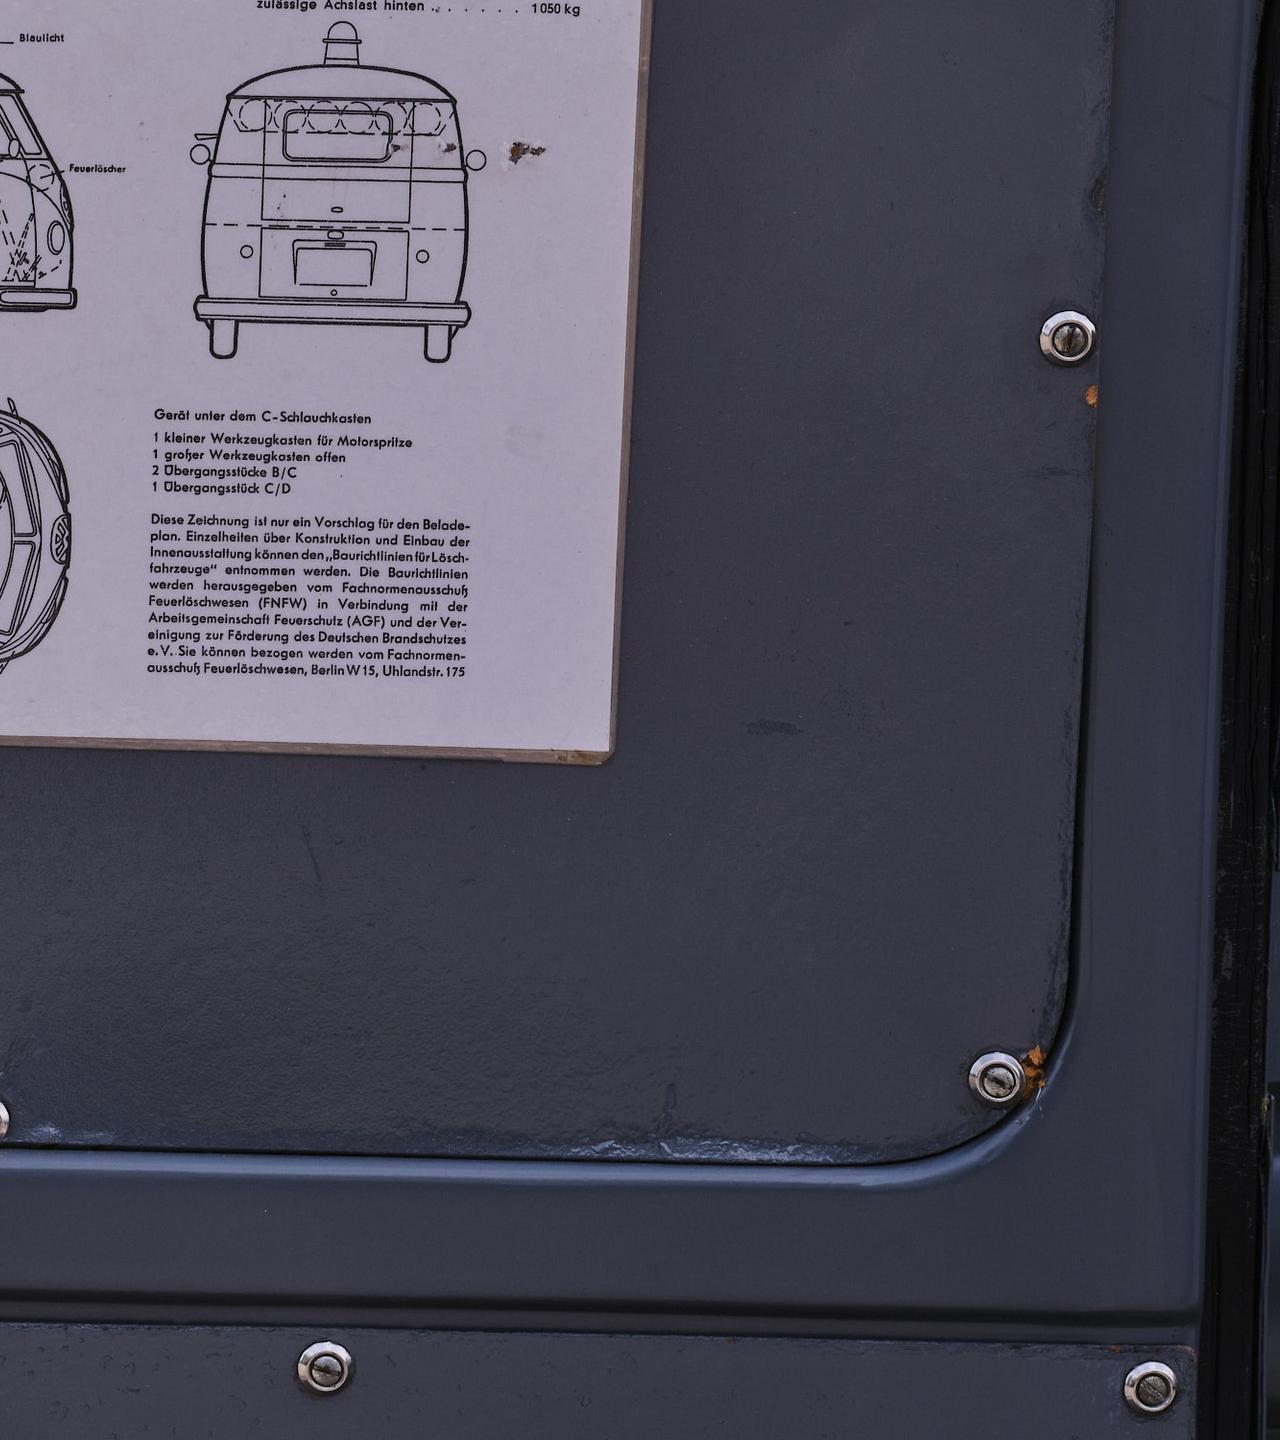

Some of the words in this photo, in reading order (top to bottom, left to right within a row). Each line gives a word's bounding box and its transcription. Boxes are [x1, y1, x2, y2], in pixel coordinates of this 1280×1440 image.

[383, 0, 425, 12] hinten
[564, 2, 581, 18] kg
[19, 32, 65, 43] Blaulicht
[68, 163, 127, 174] Feuerlöscher
[153, 407, 190, 421] Gerät
[194, 410, 226, 422] unter
[229, 409, 257, 422] dem
[261, 409, 372, 425] C-Schlauchkasten
[154, 431, 159, 443] 1
[164, 431, 206, 444] kleiner
[210, 432, 313, 448] Werkzeugkasten
[316, 434, 334, 447] für
[336, 434, 413, 451] Motorspritze
[152, 448, 158, 460] 1
[164, 448, 205, 463] großer
[208, 448, 311, 464] Werkzeugkasten
[314, 450, 346, 463] offen
[151, 464, 160, 476] 2
[164, 464, 267, 480] Übergangsstücke
[272, 466, 297, 480] B/C
[152, 480, 158, 493] 1
[163, 480, 260, 497] Übergangsstück
[264, 482, 292, 497] C/D
[150, 512, 185, 525] Diese
[186, 513, 250, 529] Zeichnung
[254, 515, 268, 527] ist
[270, 518, 290, 528] nur
[292, 516, 312, 528] ein
[314, 515, 375, 532] Vorschlag
[377, 517, 394, 530] für
[396, 517, 420, 530] den
[422, 518, 471, 531] Belade-
[150, 529, 181, 544] plan.
[186, 530, 259, 543] Einzelheiten
[263, 531, 291, 544] über
[295, 531, 371, 545] Konstruktion
[375, 533, 399, 546] und
[403, 534, 445, 547] Einbau
[449, 535, 471, 548] der
[150, 545, 252, 562] Innenausstattung
[254, 547, 299, 560] können
[300, 548, 325, 561] den
[414, 550, 431, 563] für
[431, 551, 470, 564] Lösch-
[224, 564, 296, 577] entnommen
[303, 565, 351, 577] werden.
[359, 566, 380, 578] Die
[388, 566, 469, 580] Baurichtlinien
[148, 578, 194, 591] werden
[203, 579, 297, 595] herausgegeben
[306, 584, 333, 593] vom
[342, 581, 469, 599] Fachnormenausschuß
[148, 594, 249, 608] Feuerlöschwesen
[258, 596, 308, 612] (FNFW)
[317, 598, 329, 610] in
[337, 597, 409, 614] Verbindung
[419, 600, 438, 612] mit
[447, 600, 469, 613] der
[148, 611, 270, 626] Arbeitsgemeinschaft
[274, 613, 344, 627] Feuerschutz
[347, 614, 386, 630] (AGF)
[390, 615, 413, 628] und
[416, 615, 438, 628] der
[439, 616, 468, 629] Ver-
[147, 628, 201, 643] einigung
[205, 632, 224, 641] zur
[227, 629, 289, 645] Förderung
[293, 630, 316, 642] des
[318, 630, 379, 644] Deutschen
[382, 631, 467, 645] Brandschutzes
[147, 647, 159, 657] e.
[178, 644, 197, 657] Sie
[201, 645, 246, 658] können
[250, 645, 304, 661] bezogen
[308, 647, 354, 659] werden
[358, 651, 384, 660] vom
[387, 648, 466, 662] Fachnormen-
[146, 661, 201, 676] ausschuß
[203, 662, 308, 677] Feuerlöschwesen,
[311, 663, 345, 676] Berlin
[382, 664, 444, 678] Uhlandstr.
[446, 666, 466, 678] 175
